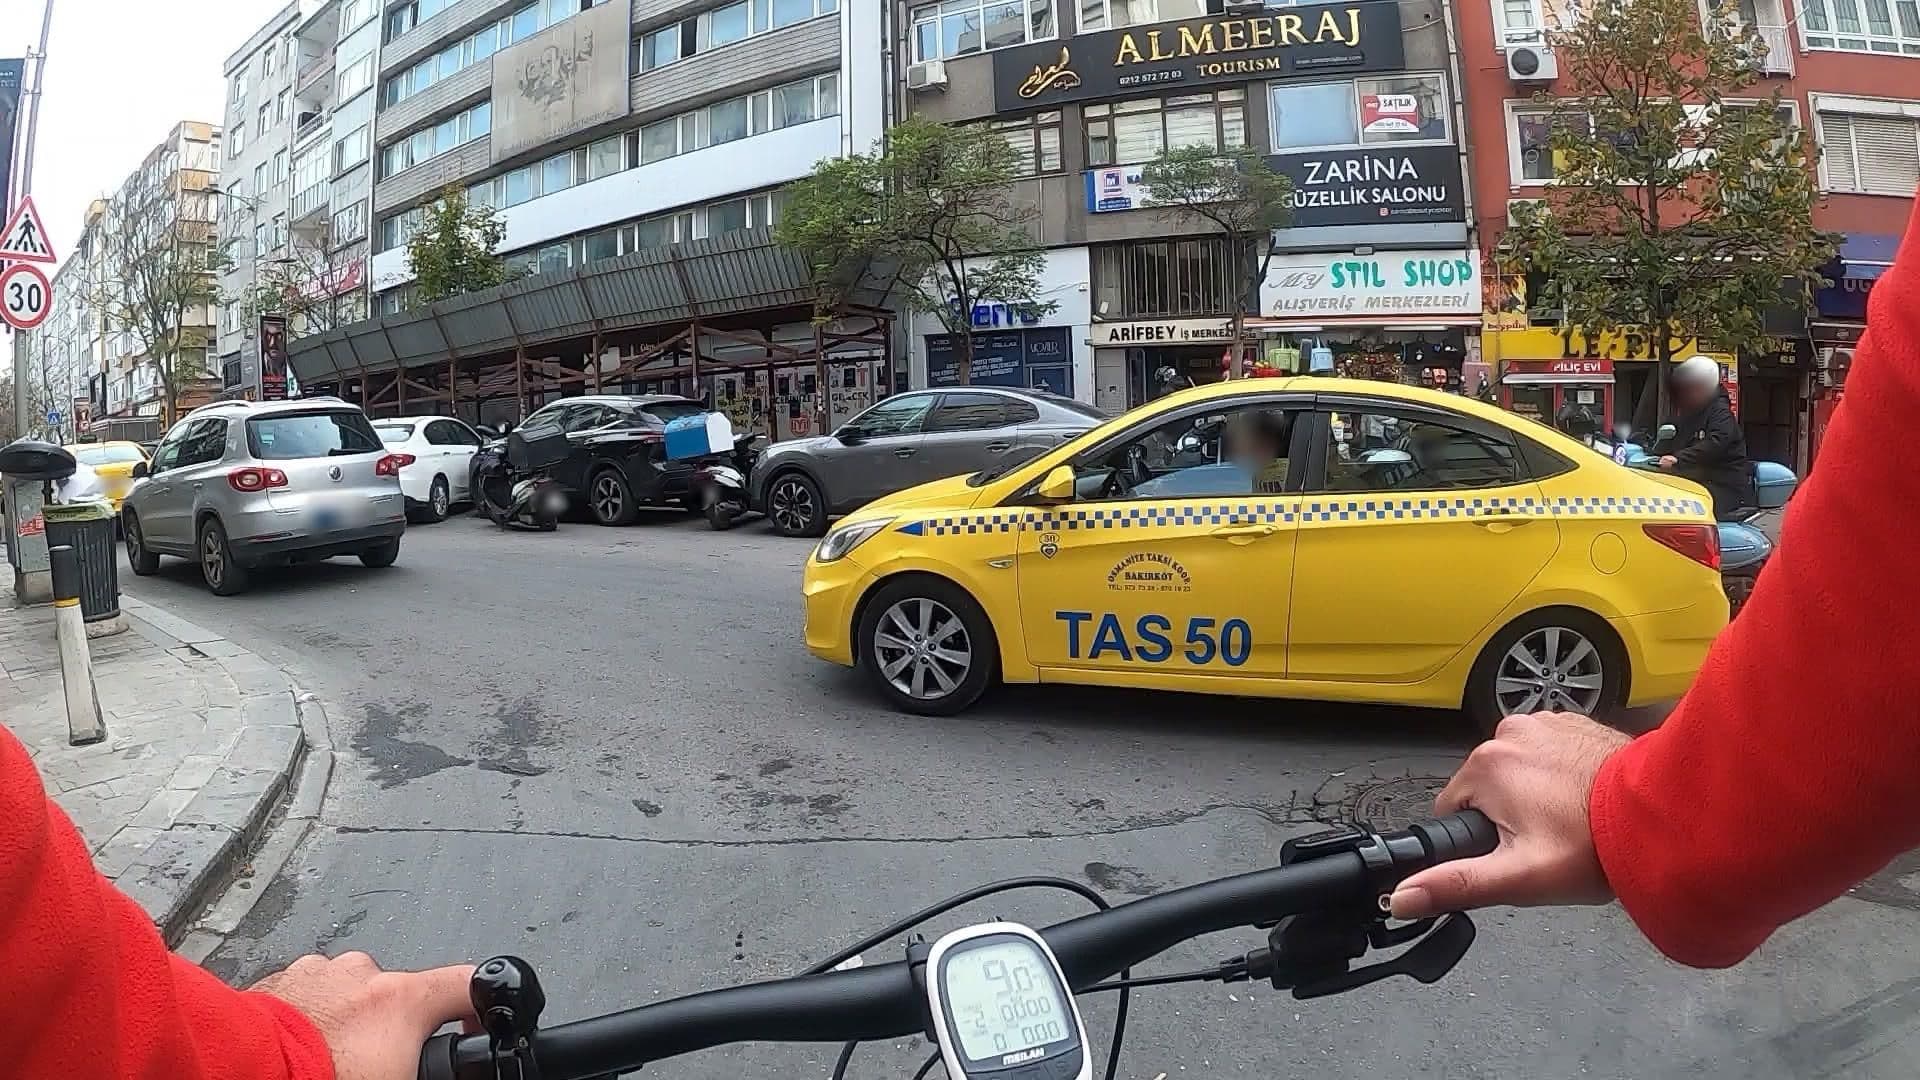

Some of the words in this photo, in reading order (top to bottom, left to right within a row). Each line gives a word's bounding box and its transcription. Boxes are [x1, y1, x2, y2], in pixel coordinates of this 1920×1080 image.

[1115, 8, 1361, 66] ALMEERAJ
[1198, 56, 1280, 78] TOURISM
[1303, 155, 1419, 185] ZARİNA
[1372, 185, 1446, 205] SALONU
[1403, 259, 1473, 288] SHOP
[9, 282, 41, 312] 30
[1273, 294, 1355, 313] ALIŞVERİŞ
[1364, 292, 1470, 310] MERKEZLERİ
[1109, 323, 1177, 342] ARİFBEY
[1056, 611, 1173, 662] TAS
[1183, 617, 1253, 667] 50
